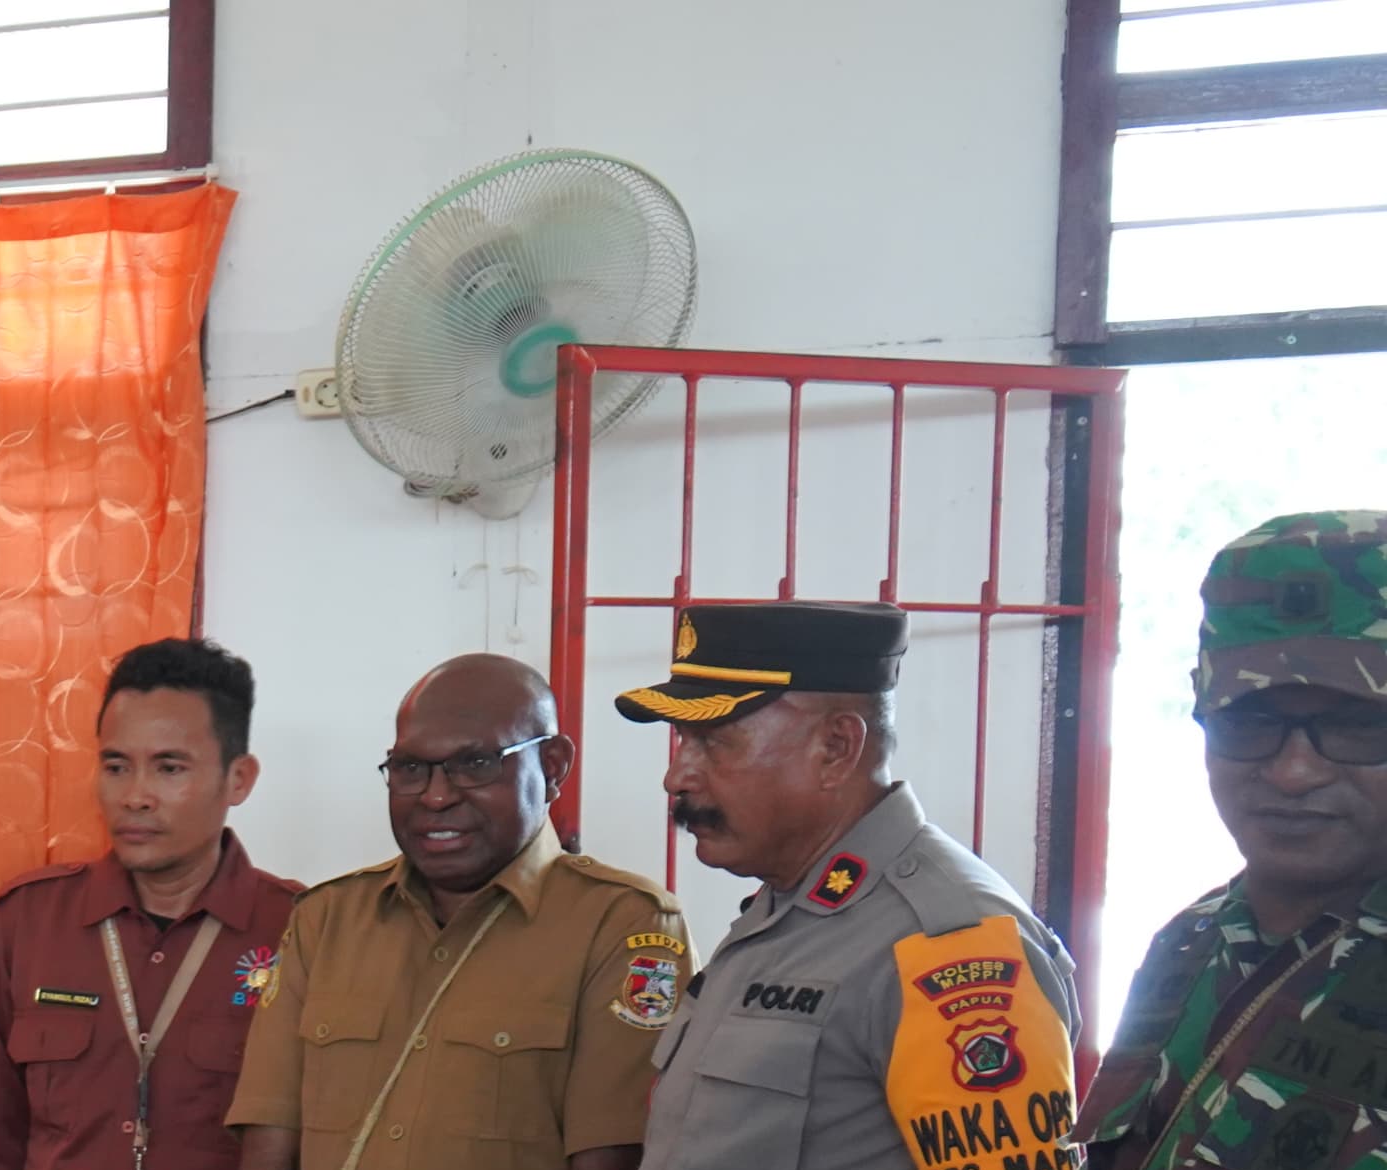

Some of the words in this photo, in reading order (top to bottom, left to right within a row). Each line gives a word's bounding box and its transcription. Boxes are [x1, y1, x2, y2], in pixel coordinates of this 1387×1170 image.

[634, 935, 679, 952] SETDA
[931, 961, 1004, 983] POLRES
[939, 970, 1001, 990] MAPPI
[233, 991, 259, 1007] BK
[742, 983, 825, 1014] POLRI
[948, 996, 1004, 1013] PAPUA
[911, 1099, 1020, 1166] WAKA
